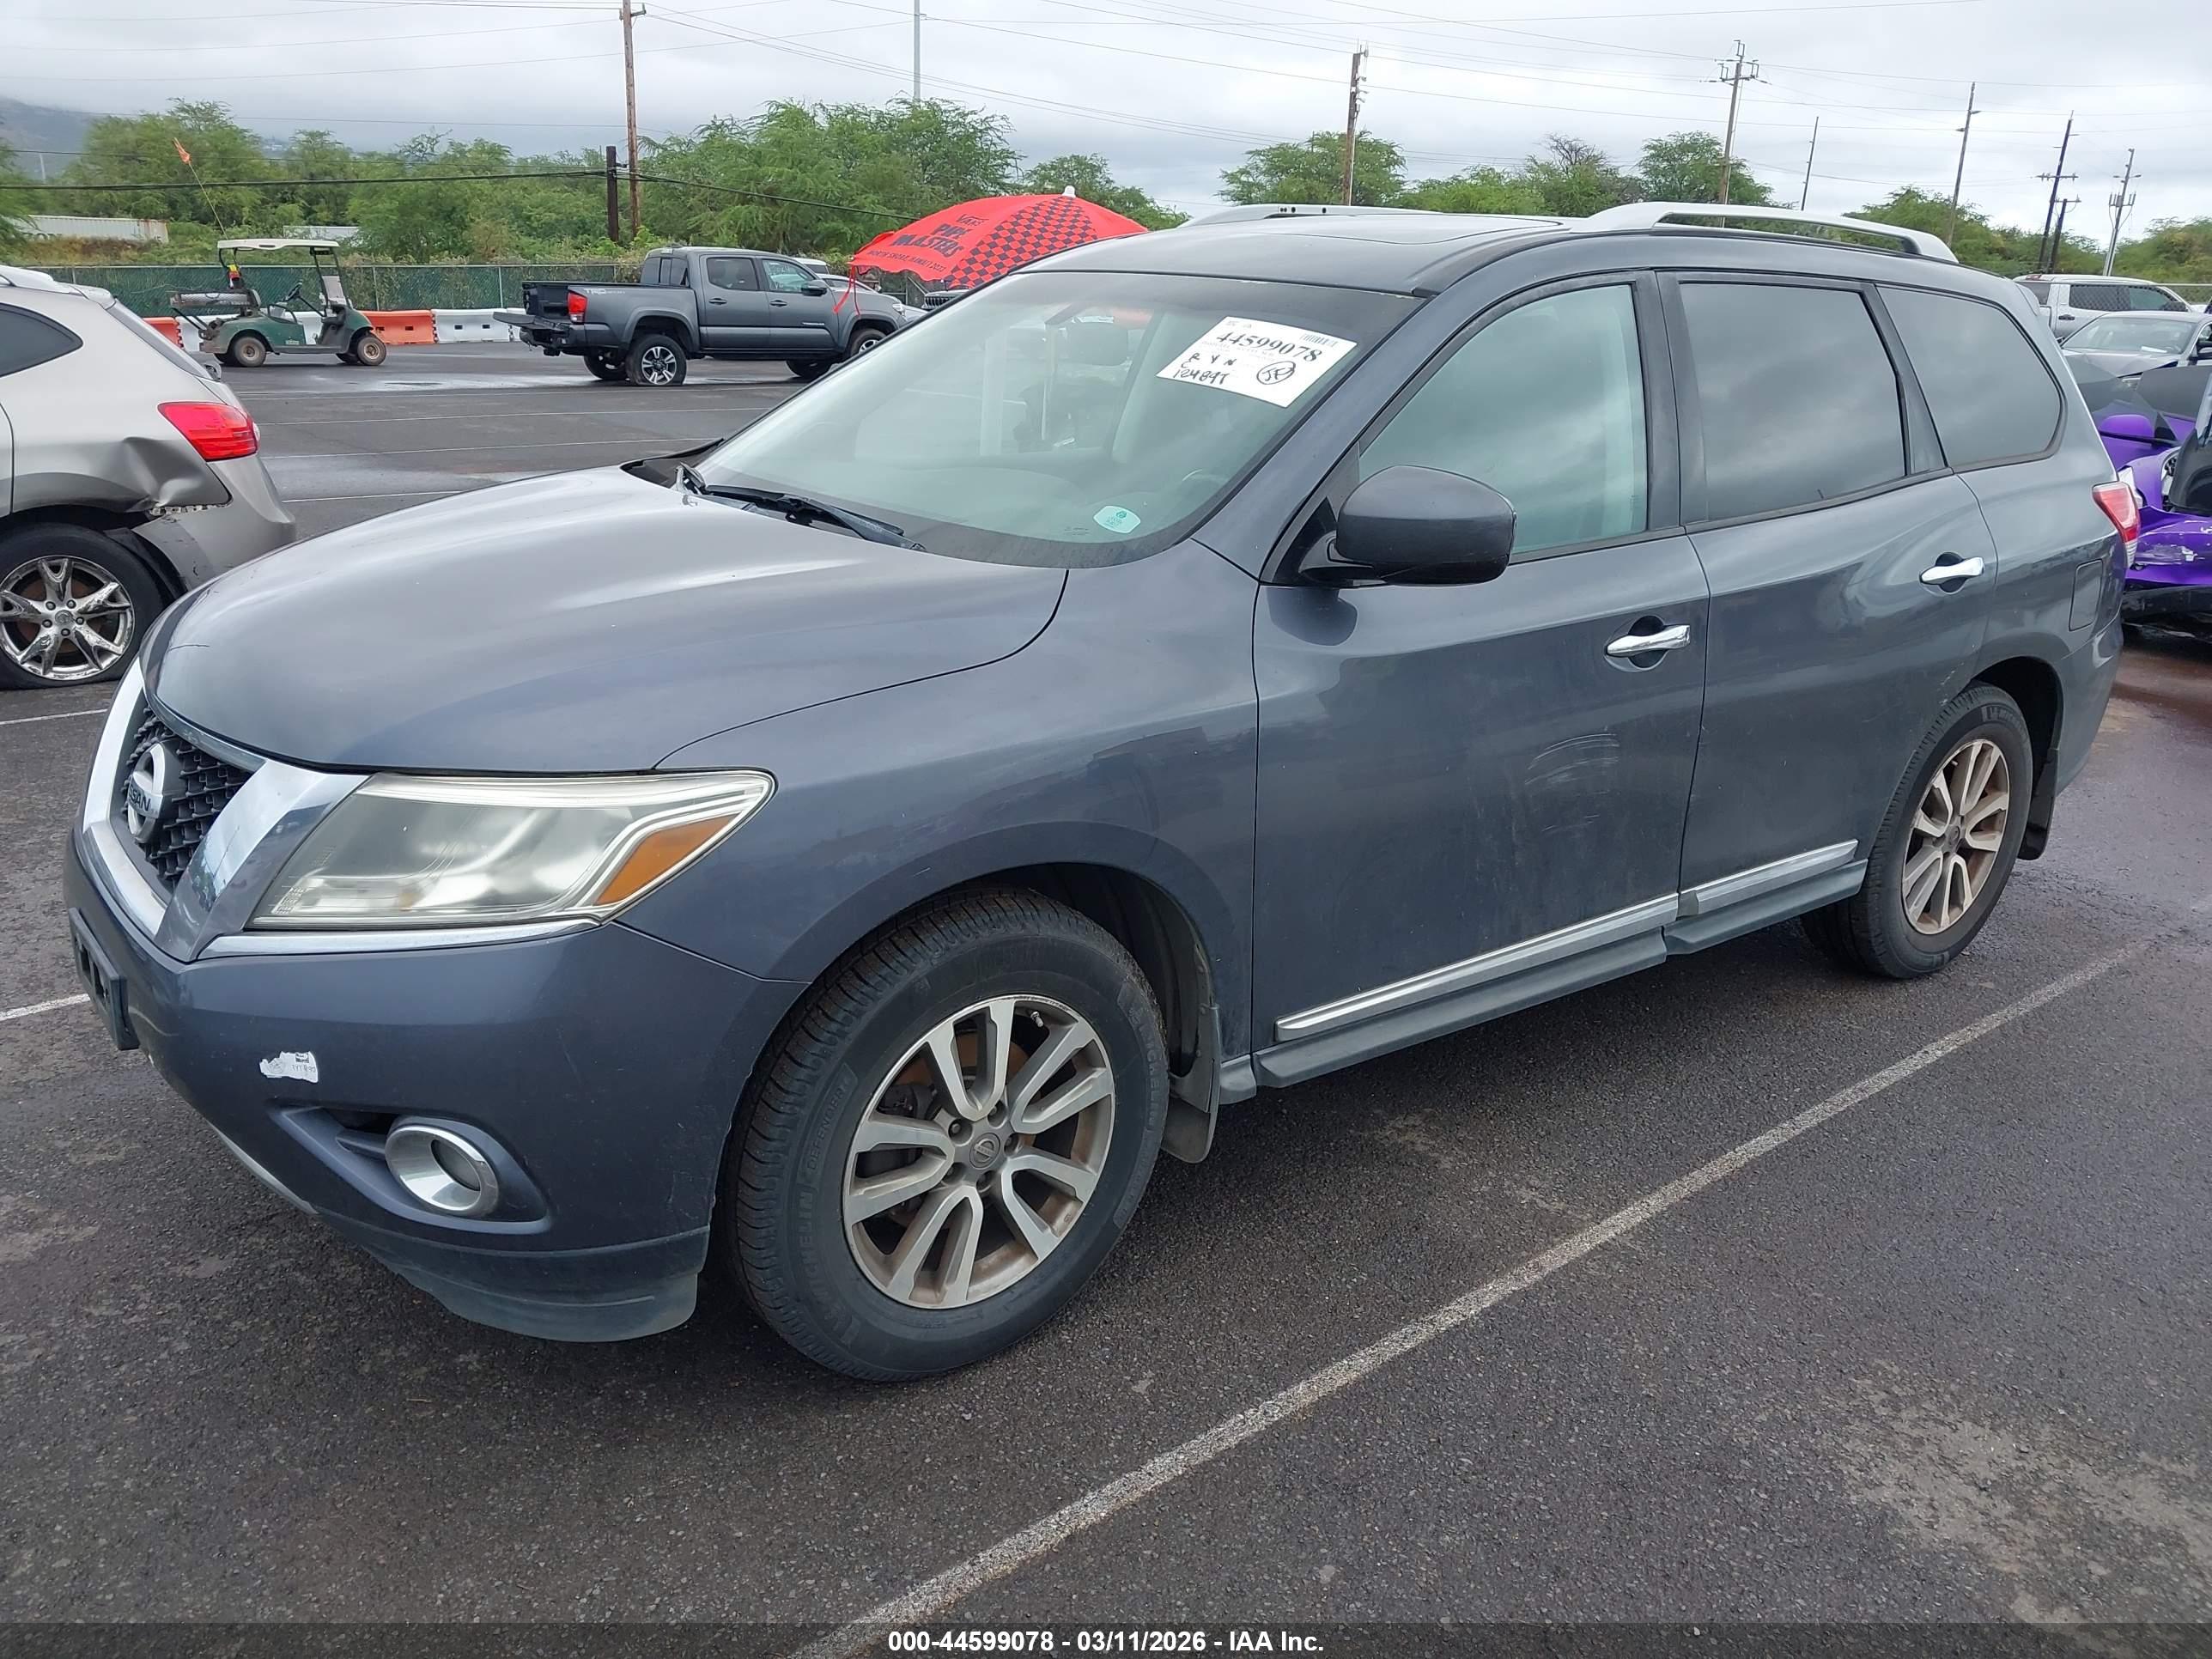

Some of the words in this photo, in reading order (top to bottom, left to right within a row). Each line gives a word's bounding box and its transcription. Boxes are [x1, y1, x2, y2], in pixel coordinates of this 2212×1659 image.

[930, 223, 973, 239] PIPE
[890, 234, 963, 258] MASTERS
[1216, 331, 1323, 362] 44599078
